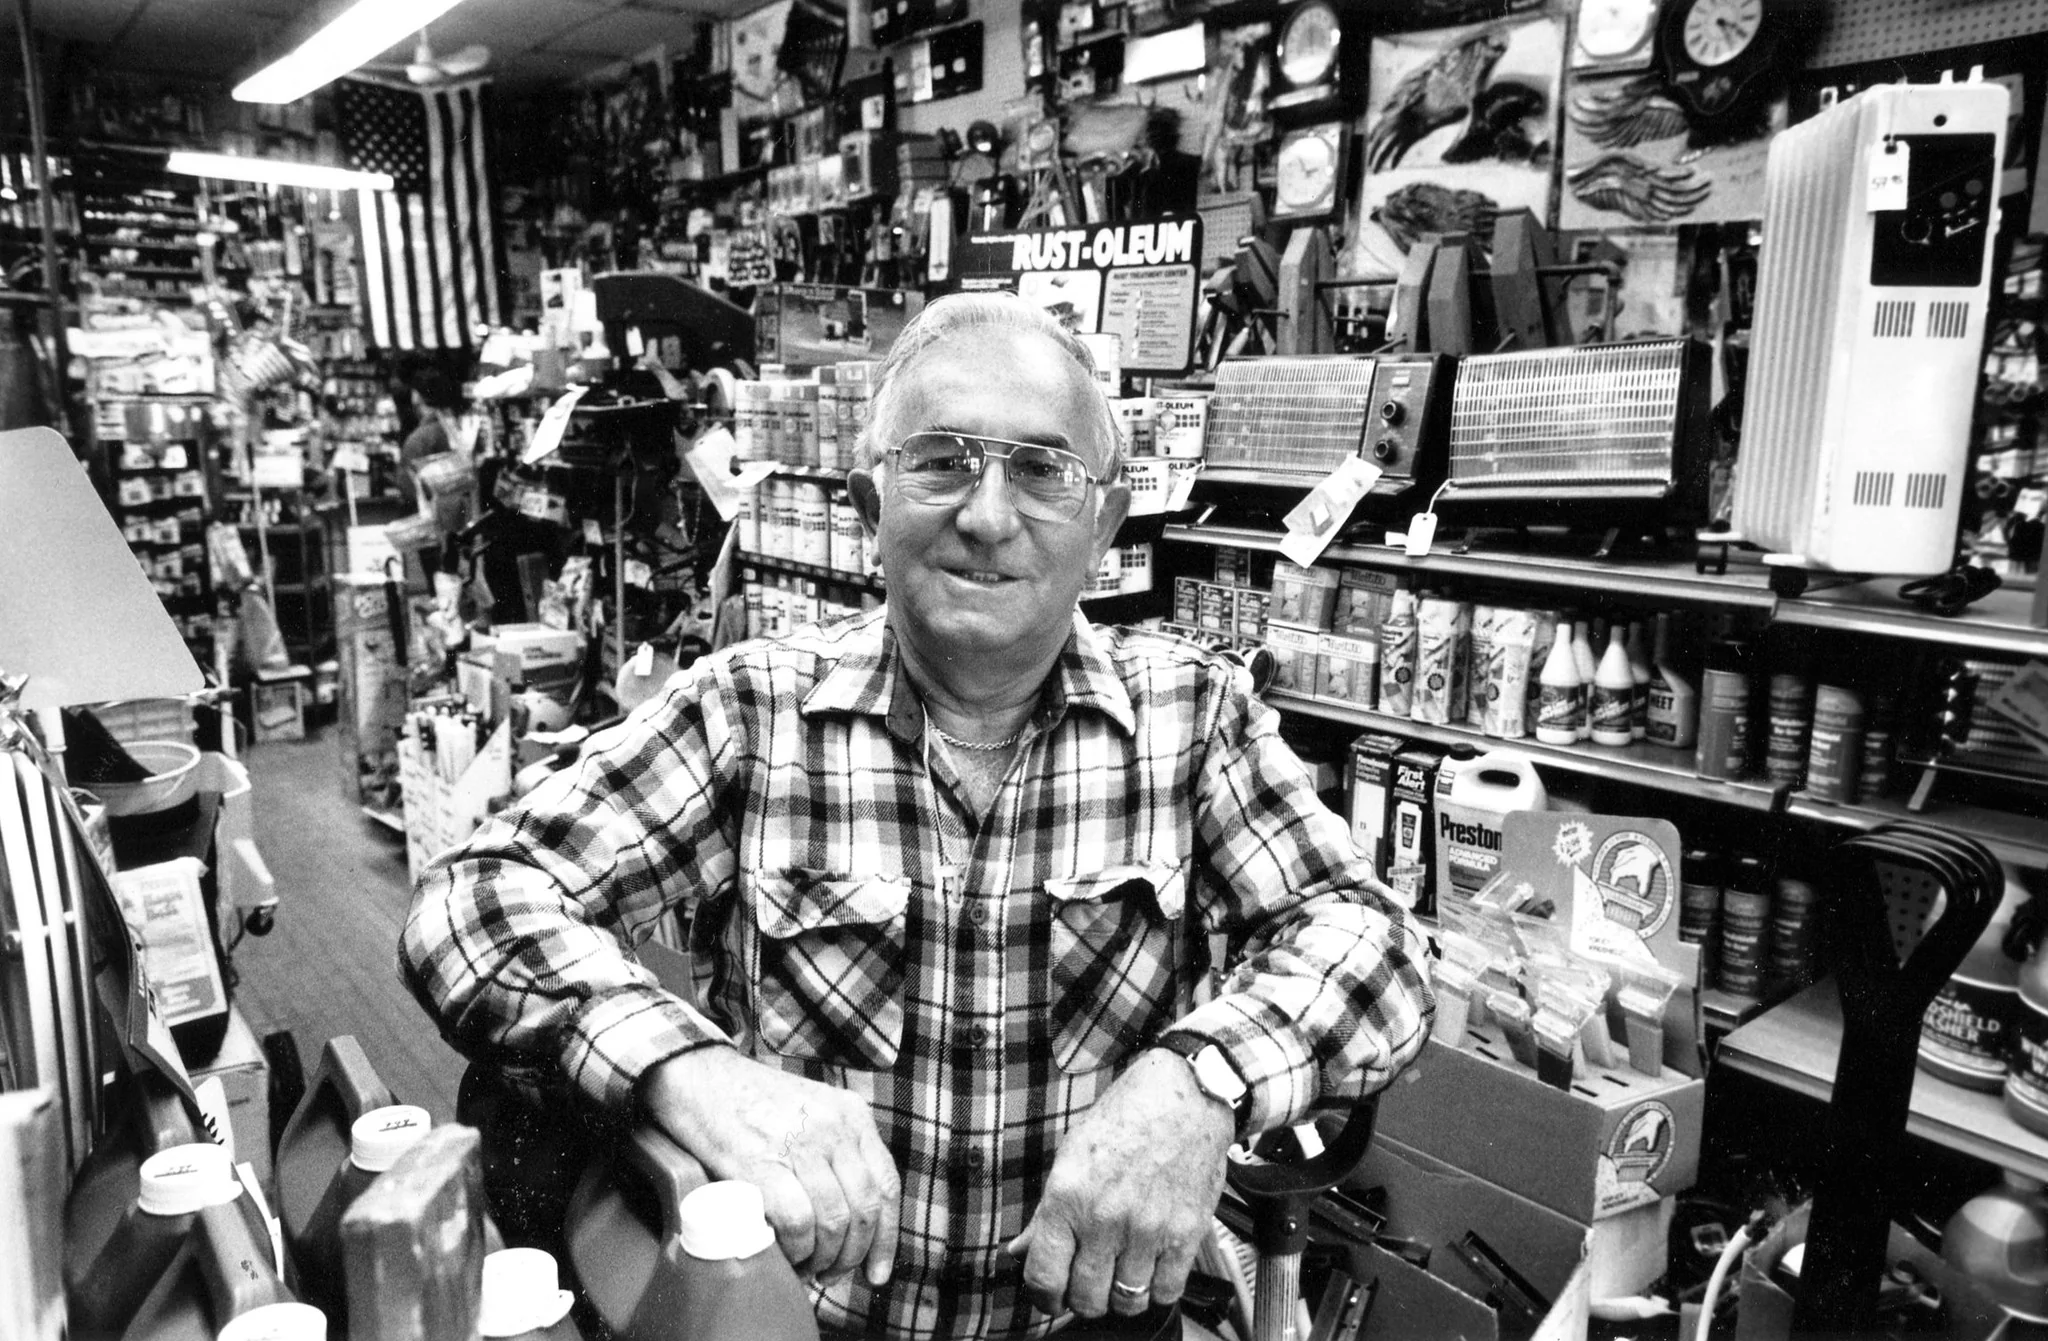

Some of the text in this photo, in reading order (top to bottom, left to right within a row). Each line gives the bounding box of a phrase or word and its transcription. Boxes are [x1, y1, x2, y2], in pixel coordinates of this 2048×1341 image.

[1012, 220, 1197, 271] RUST-OLEUM
[1121, 465, 1149, 473] OLEUM
[1397, 765, 1424, 781] First
[1396, 775, 1426, 791] Alert
[1440, 812, 1502, 851] Preston
[1449, 846, 1498, 865] ADVANCED
[1449, 854, 1490, 872] FORMULA
[1927, 1001, 2001, 1033] DSHIELD
[1923, 1012, 1979, 1043] ASHER
